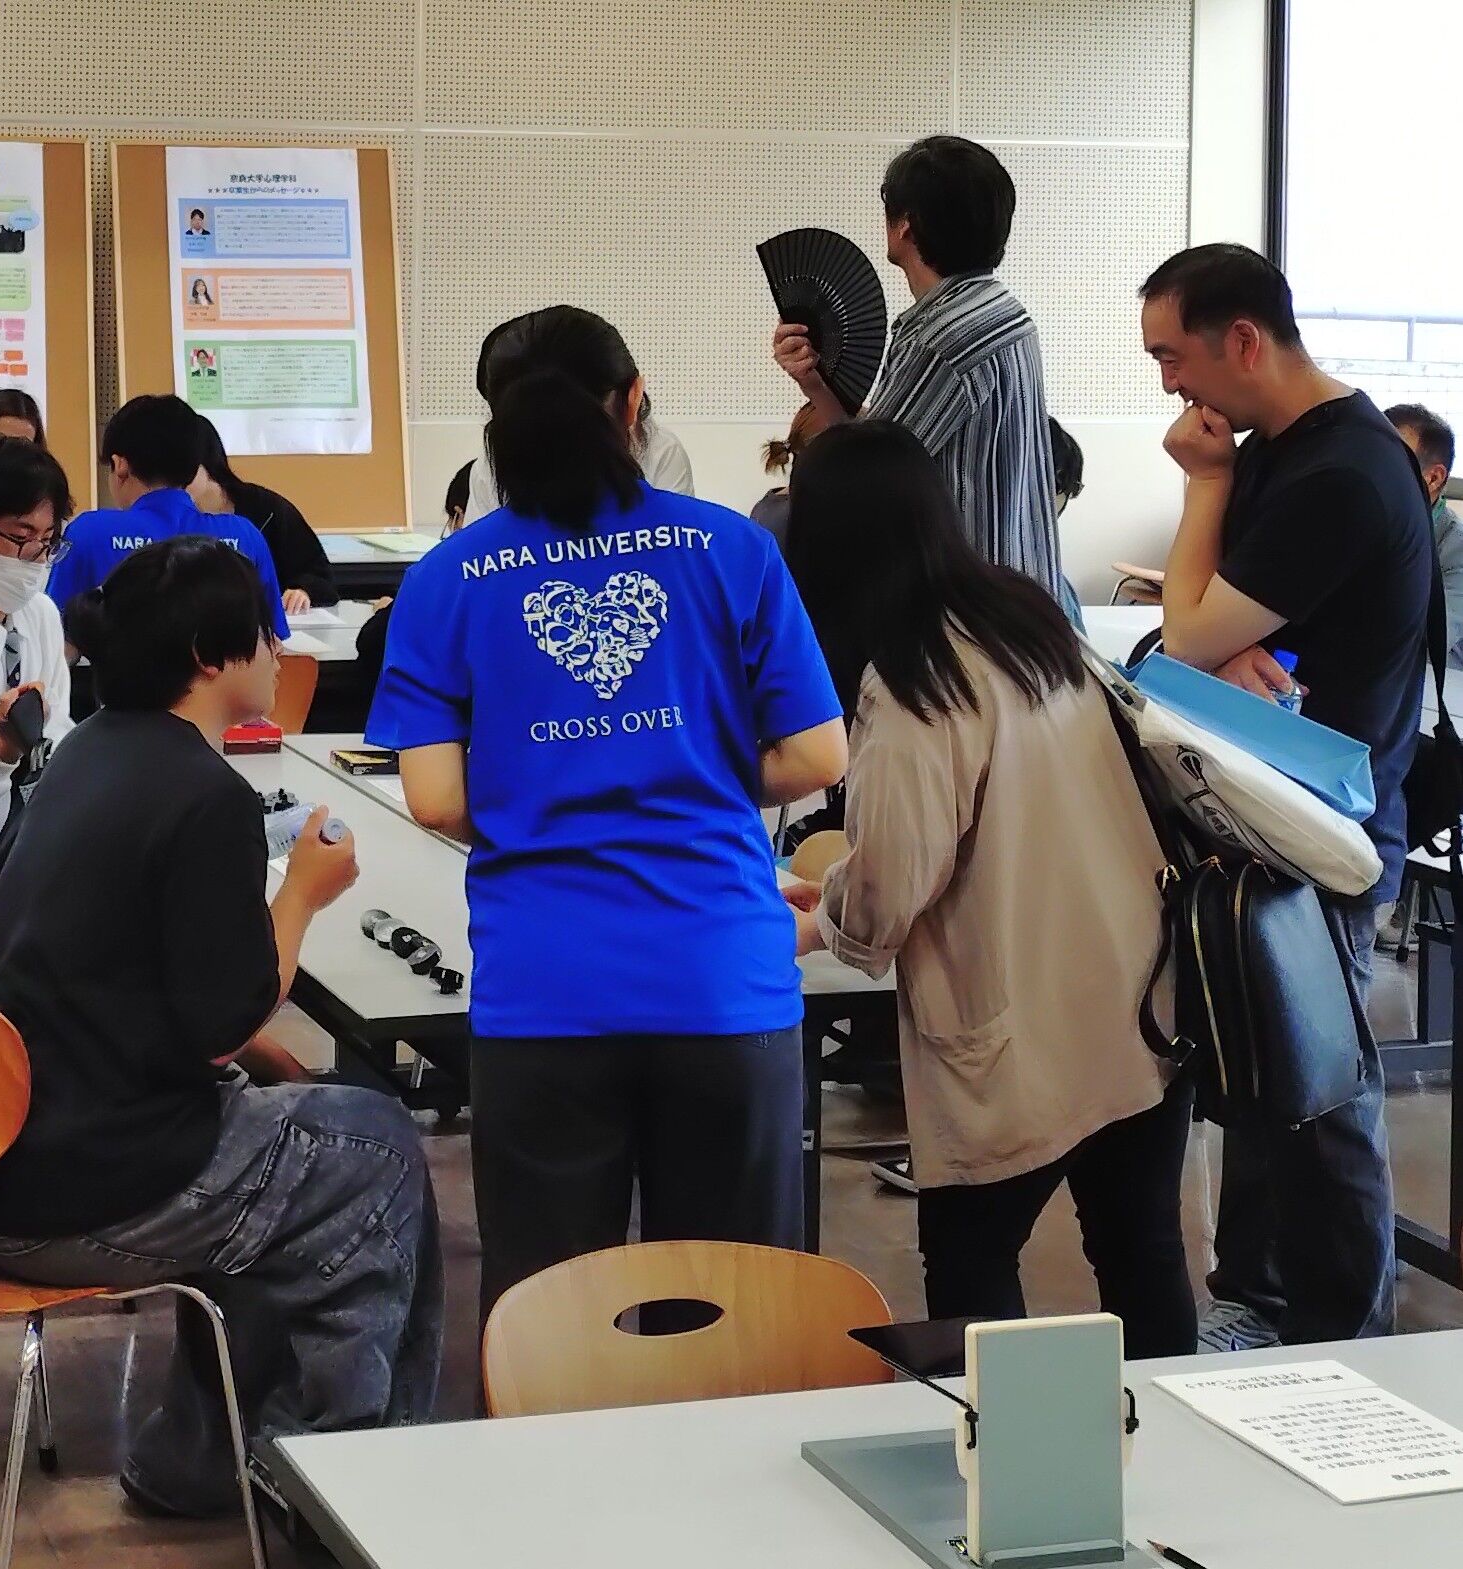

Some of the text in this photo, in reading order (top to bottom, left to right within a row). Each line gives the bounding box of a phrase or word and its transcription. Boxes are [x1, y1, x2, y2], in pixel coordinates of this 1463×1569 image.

[461, 525, 714, 581] NARA UNIVERSITY
[529, 704, 685, 743] CROSS OVER
